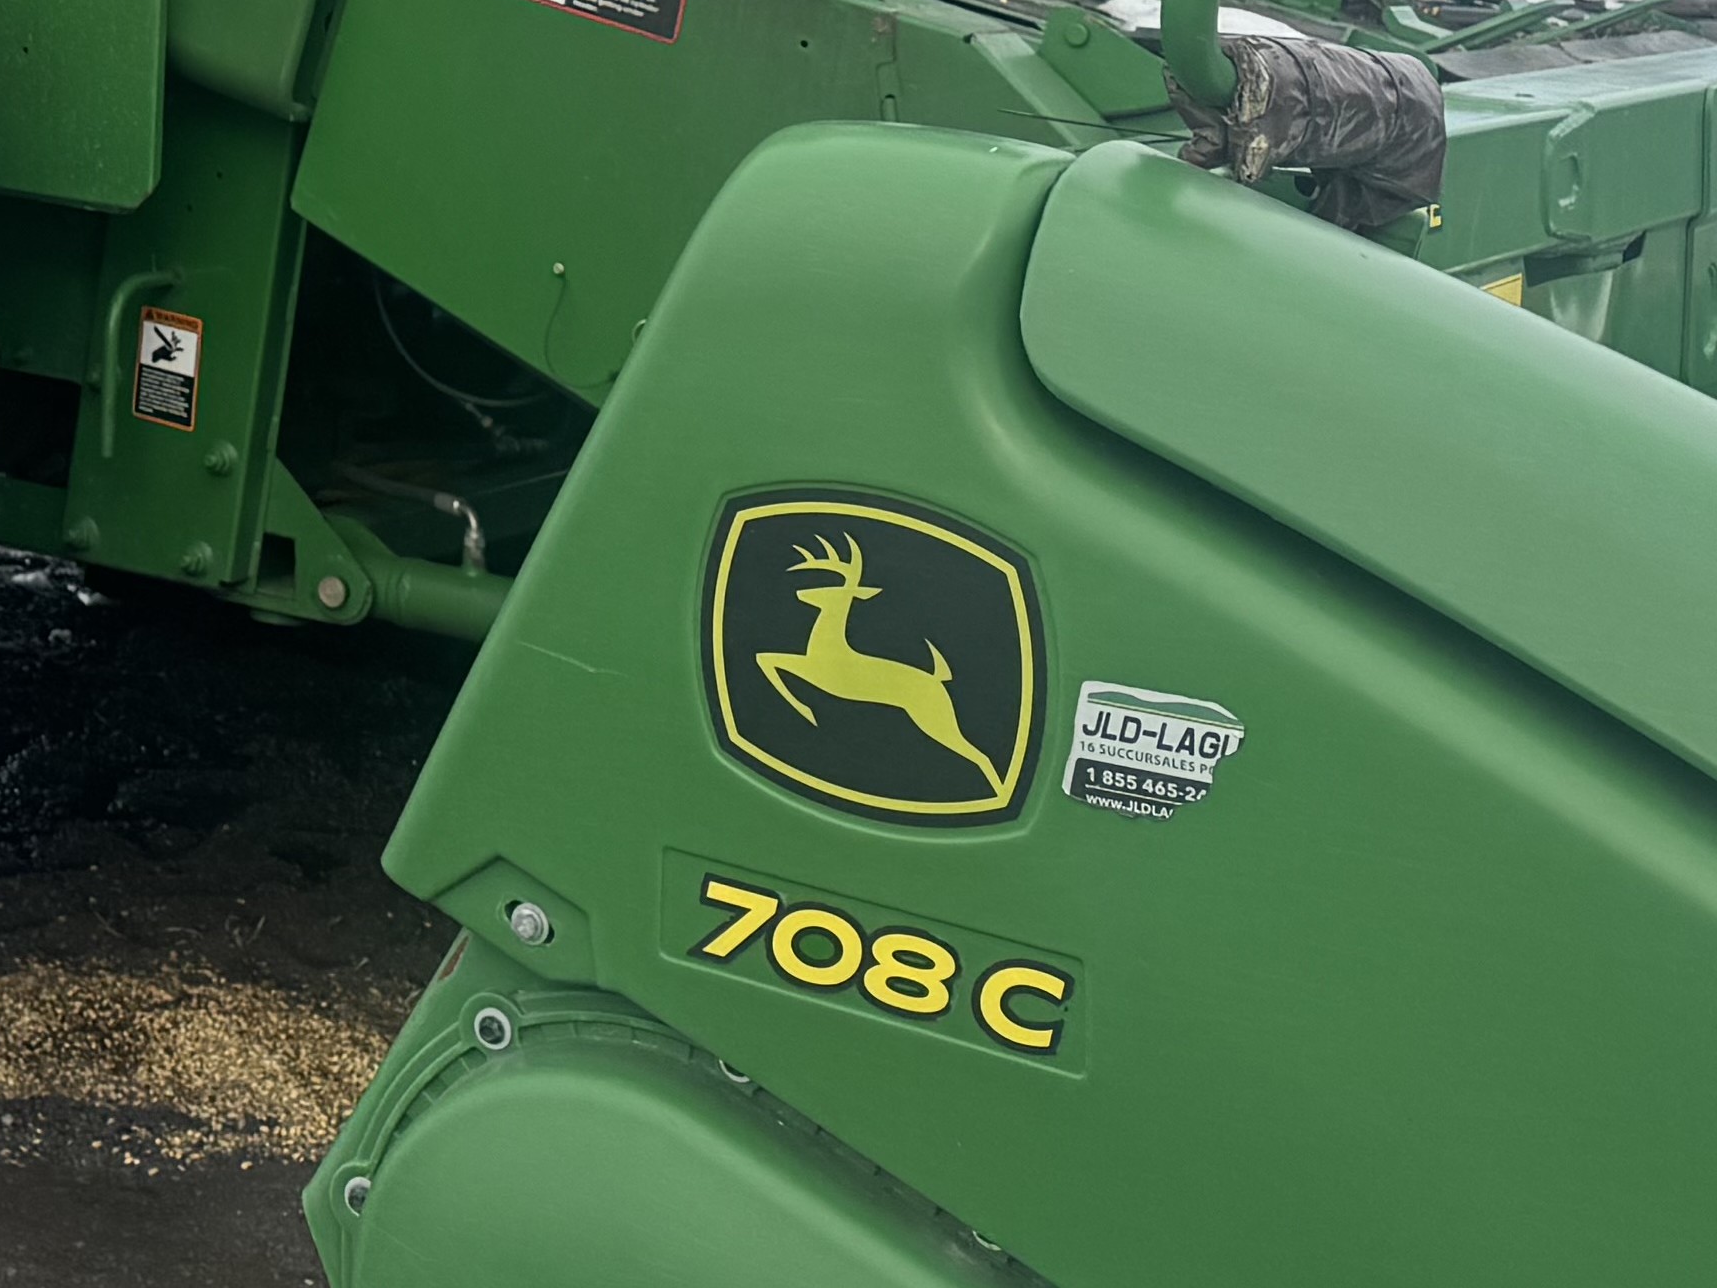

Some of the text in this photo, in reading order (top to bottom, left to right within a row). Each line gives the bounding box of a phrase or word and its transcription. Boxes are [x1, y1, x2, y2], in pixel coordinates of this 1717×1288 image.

[1080, 741, 1095, 753] 16
[1099, 744, 1195, 772] SUCCURSALES
[1086, 767, 1095, 782] 1
[1102, 770, 1138, 790] 855
[693, 875, 1070, 1052] 708 C
